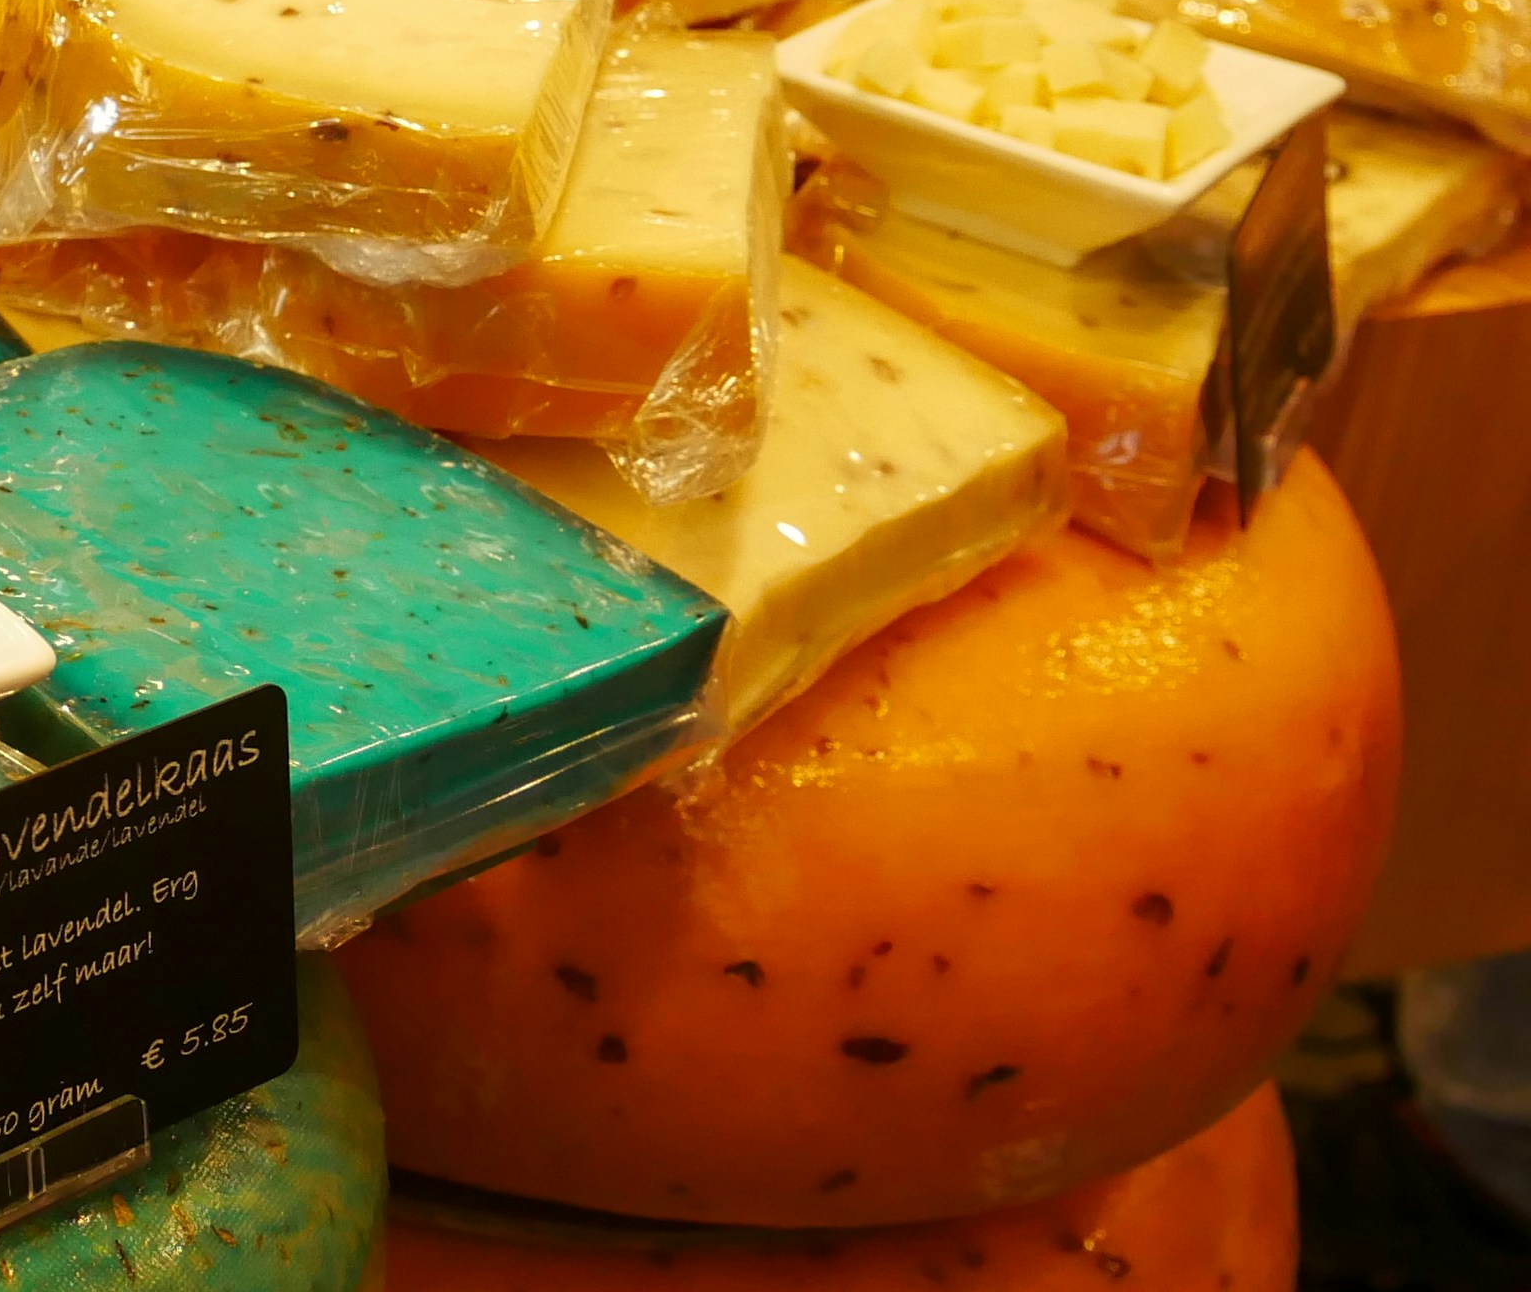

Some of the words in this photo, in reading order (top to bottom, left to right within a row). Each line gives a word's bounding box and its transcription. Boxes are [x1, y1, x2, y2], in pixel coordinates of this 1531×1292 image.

[21, 890, 142, 961] lavendel.
[152, 869, 199, 904] Erg
[12, 962, 69, 1014] zelf
[74, 930, 155, 986] maar!
[28, 1076, 105, 1132] gram
[140, 1038, 166, 1070] €
[179, 1001, 254, 1056] 5.85
